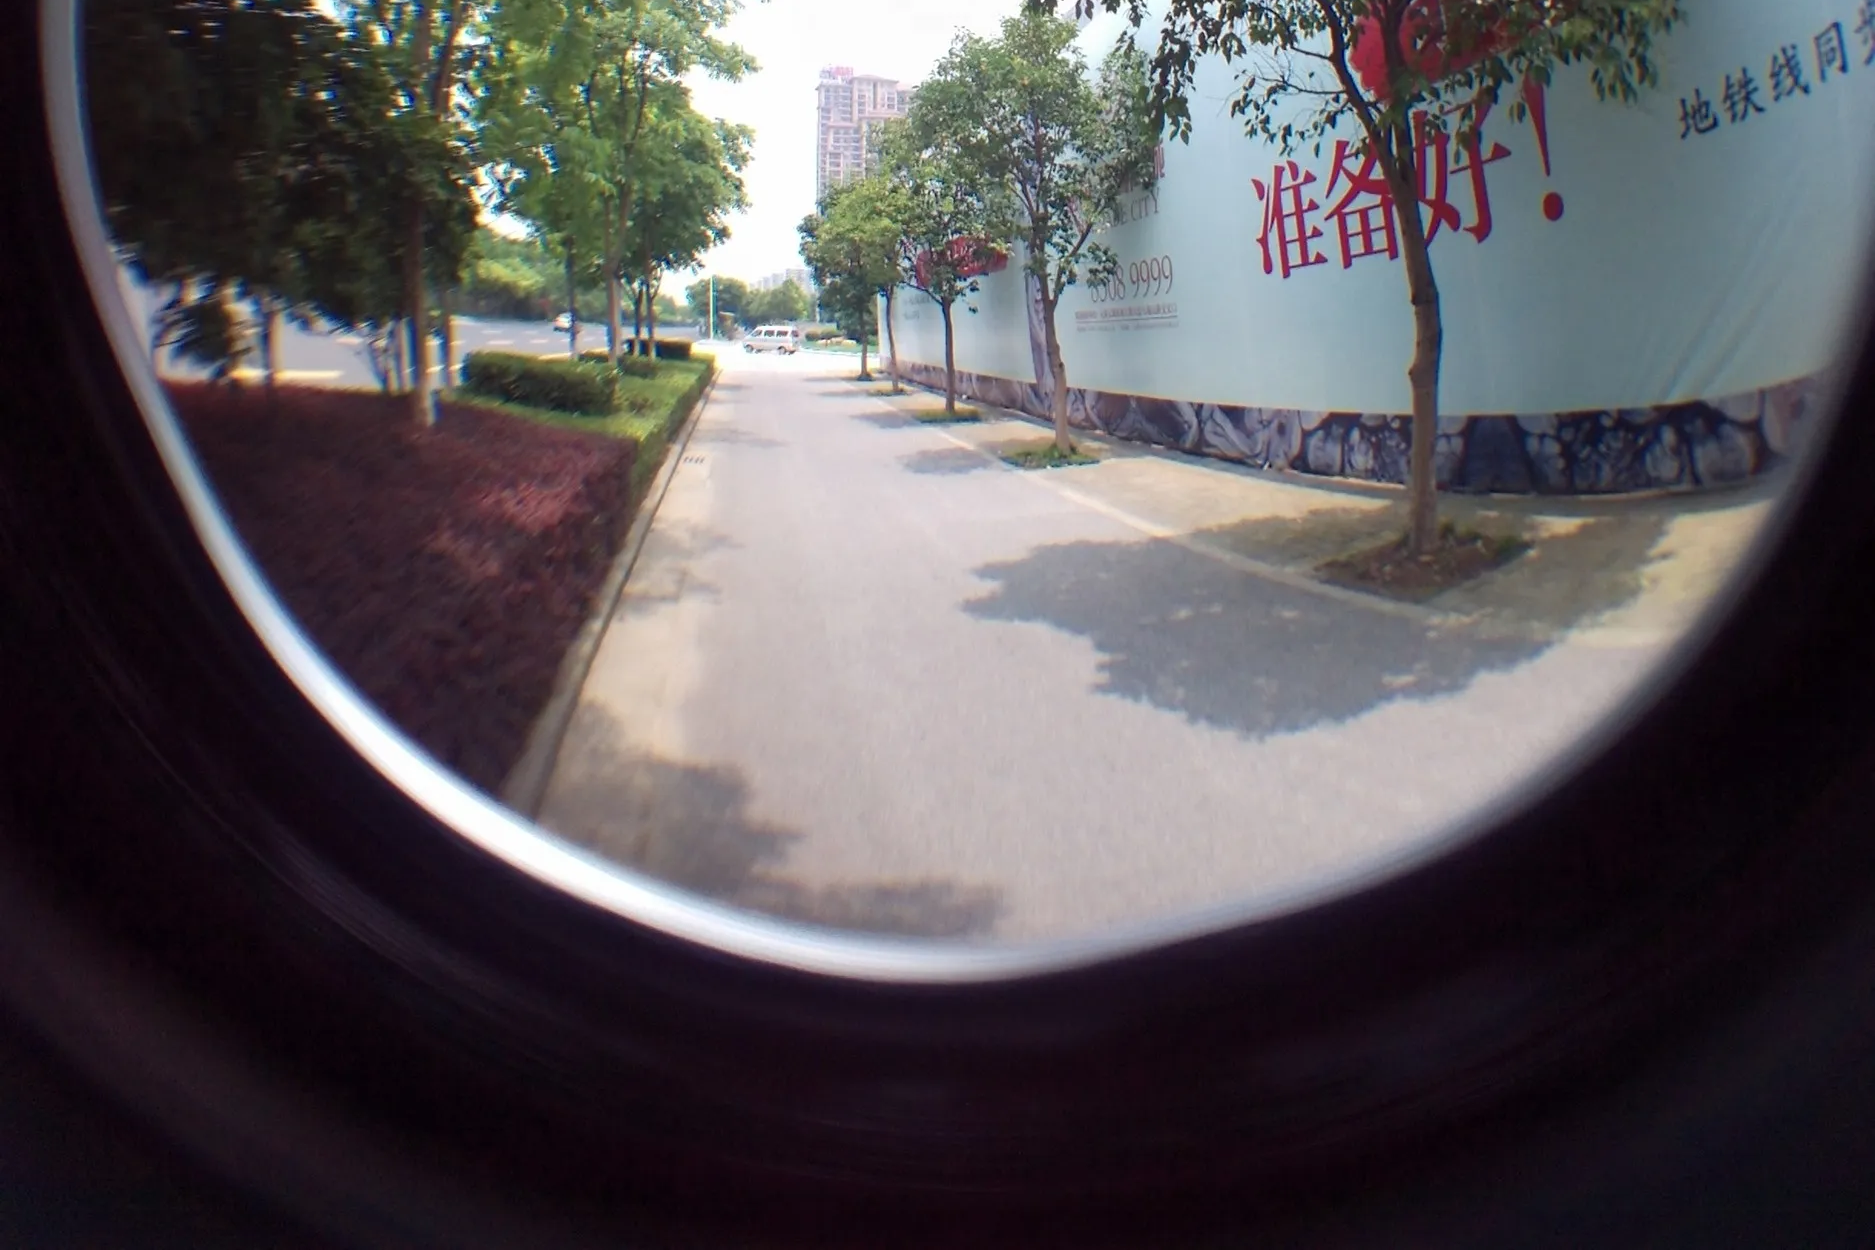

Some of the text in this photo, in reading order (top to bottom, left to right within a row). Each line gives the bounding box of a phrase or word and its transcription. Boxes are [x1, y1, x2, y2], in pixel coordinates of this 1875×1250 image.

[1250, 62, 1565, 280] 准备好！
[1130, 186, 1161, 222] CITY
[1129, 254, 1173, 299] 9999
